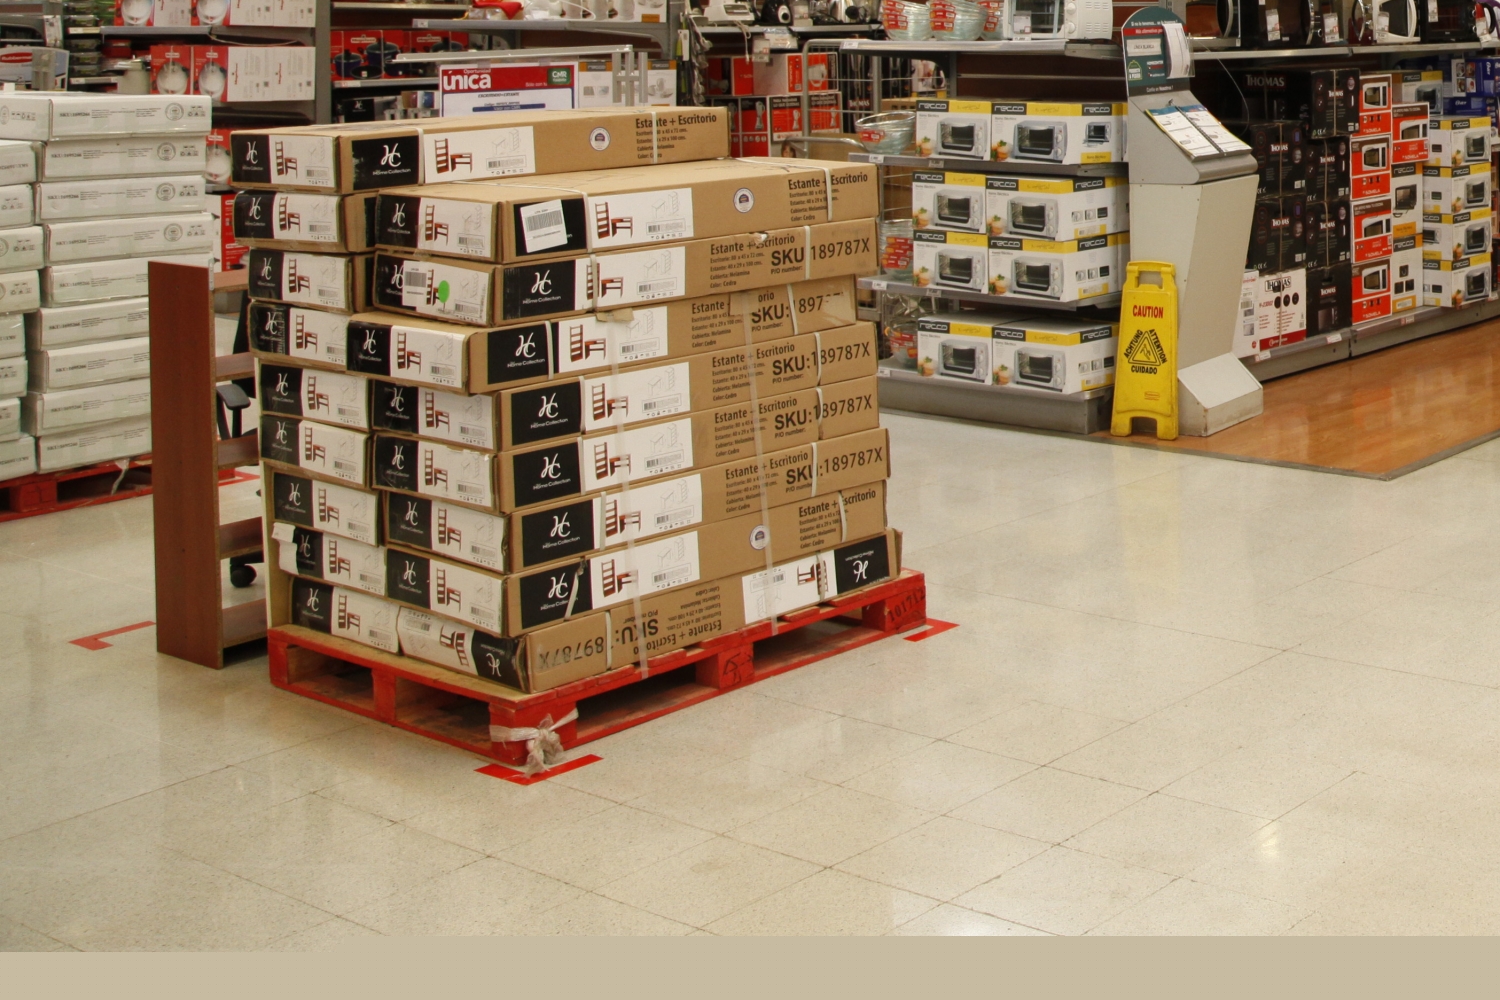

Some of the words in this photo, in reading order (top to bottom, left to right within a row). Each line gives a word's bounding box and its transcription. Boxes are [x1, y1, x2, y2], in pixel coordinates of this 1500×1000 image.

[443, 71, 491, 90] única
[1246, 75, 1284, 87] THOMAS
[679, 113, 717, 125] Escritorio
[711, 241, 744, 255] Estante
[1133, 305, 1163, 318] CAUTION
[1124, 329, 1143, 358] ACHTUNG
[1149, 329, 1167, 364] ATTENTION
[1131, 365, 1157, 374] CUIDADO
